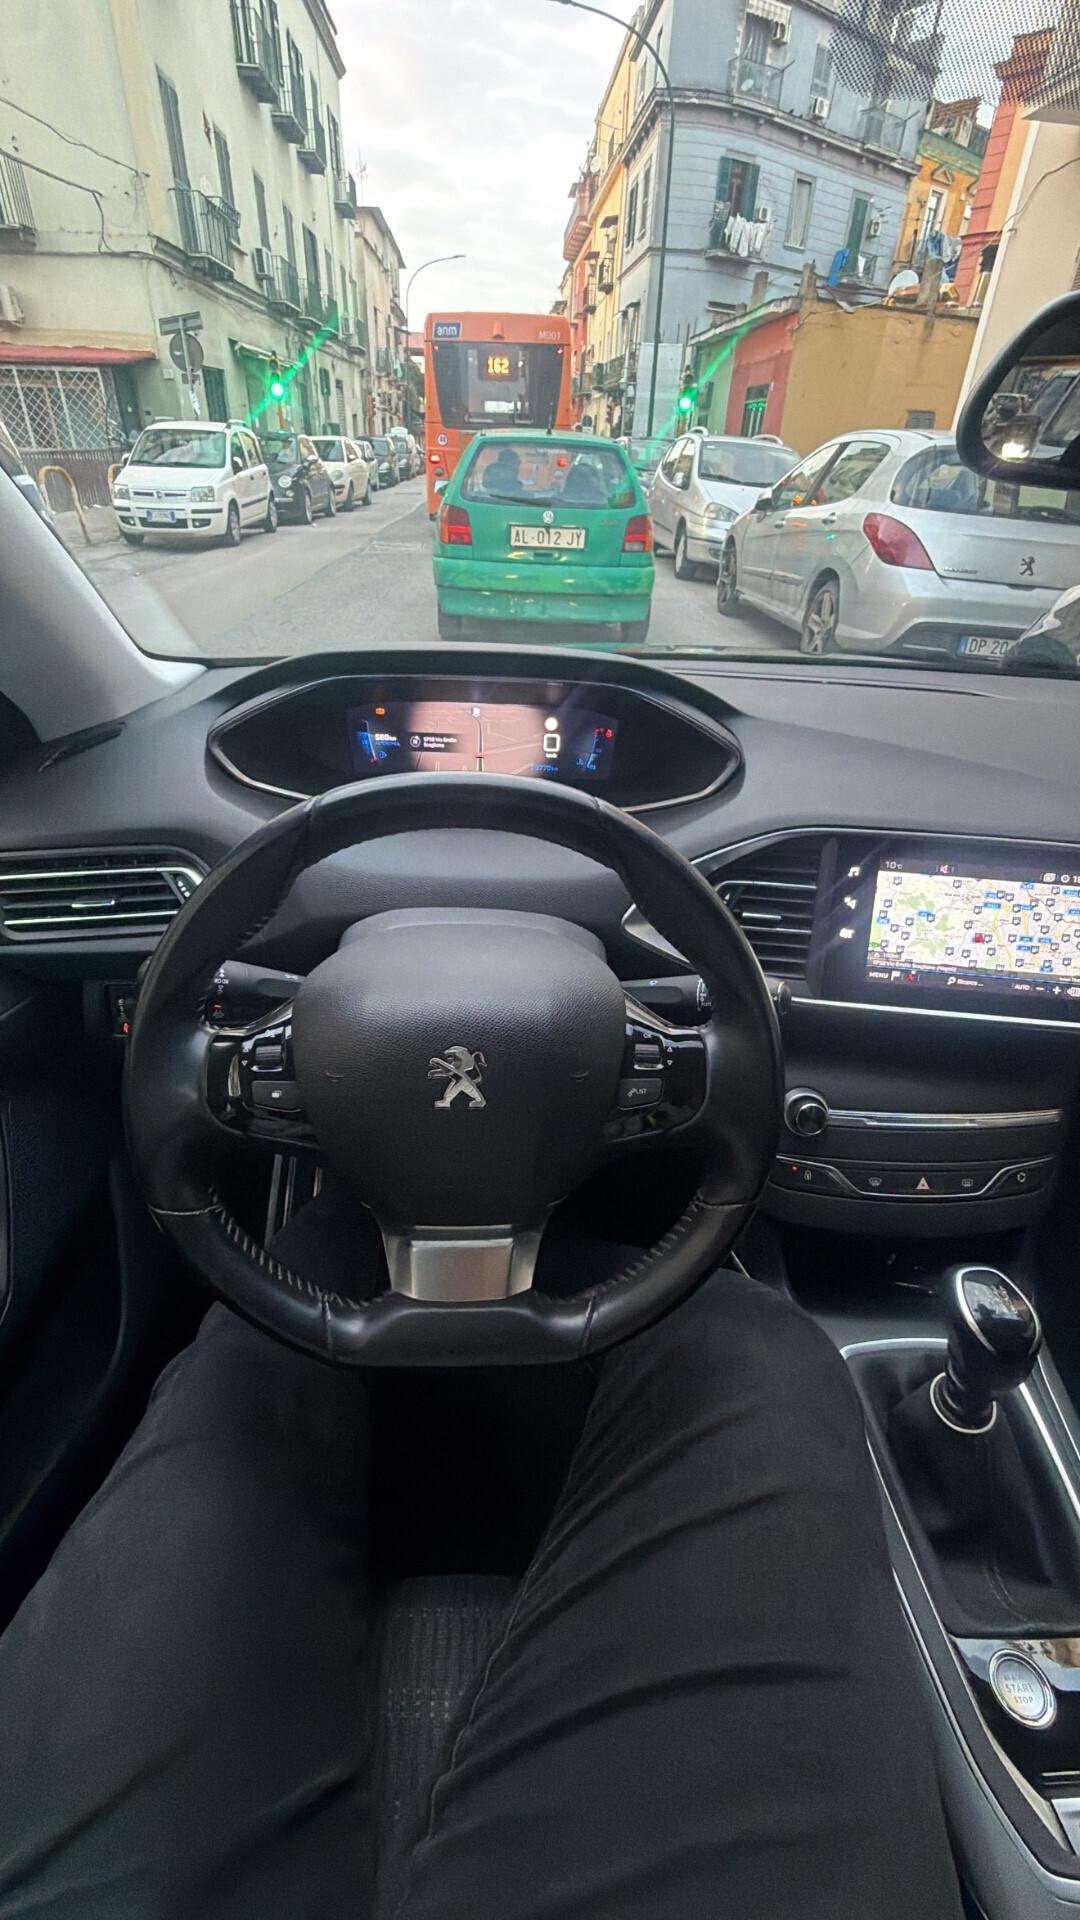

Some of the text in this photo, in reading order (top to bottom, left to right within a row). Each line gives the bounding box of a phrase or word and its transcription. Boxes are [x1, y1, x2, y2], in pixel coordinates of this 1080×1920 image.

[436, 326, 458, 336] anm
[487, 356, 510, 374] 162
[566, 532, 582, 547] JY
[969, 638, 1009, 655] DP 20
[543, 733, 561, 752] 0
[868, 971, 889, 979] MENU
[1005, 1683, 1034, 1693] START
